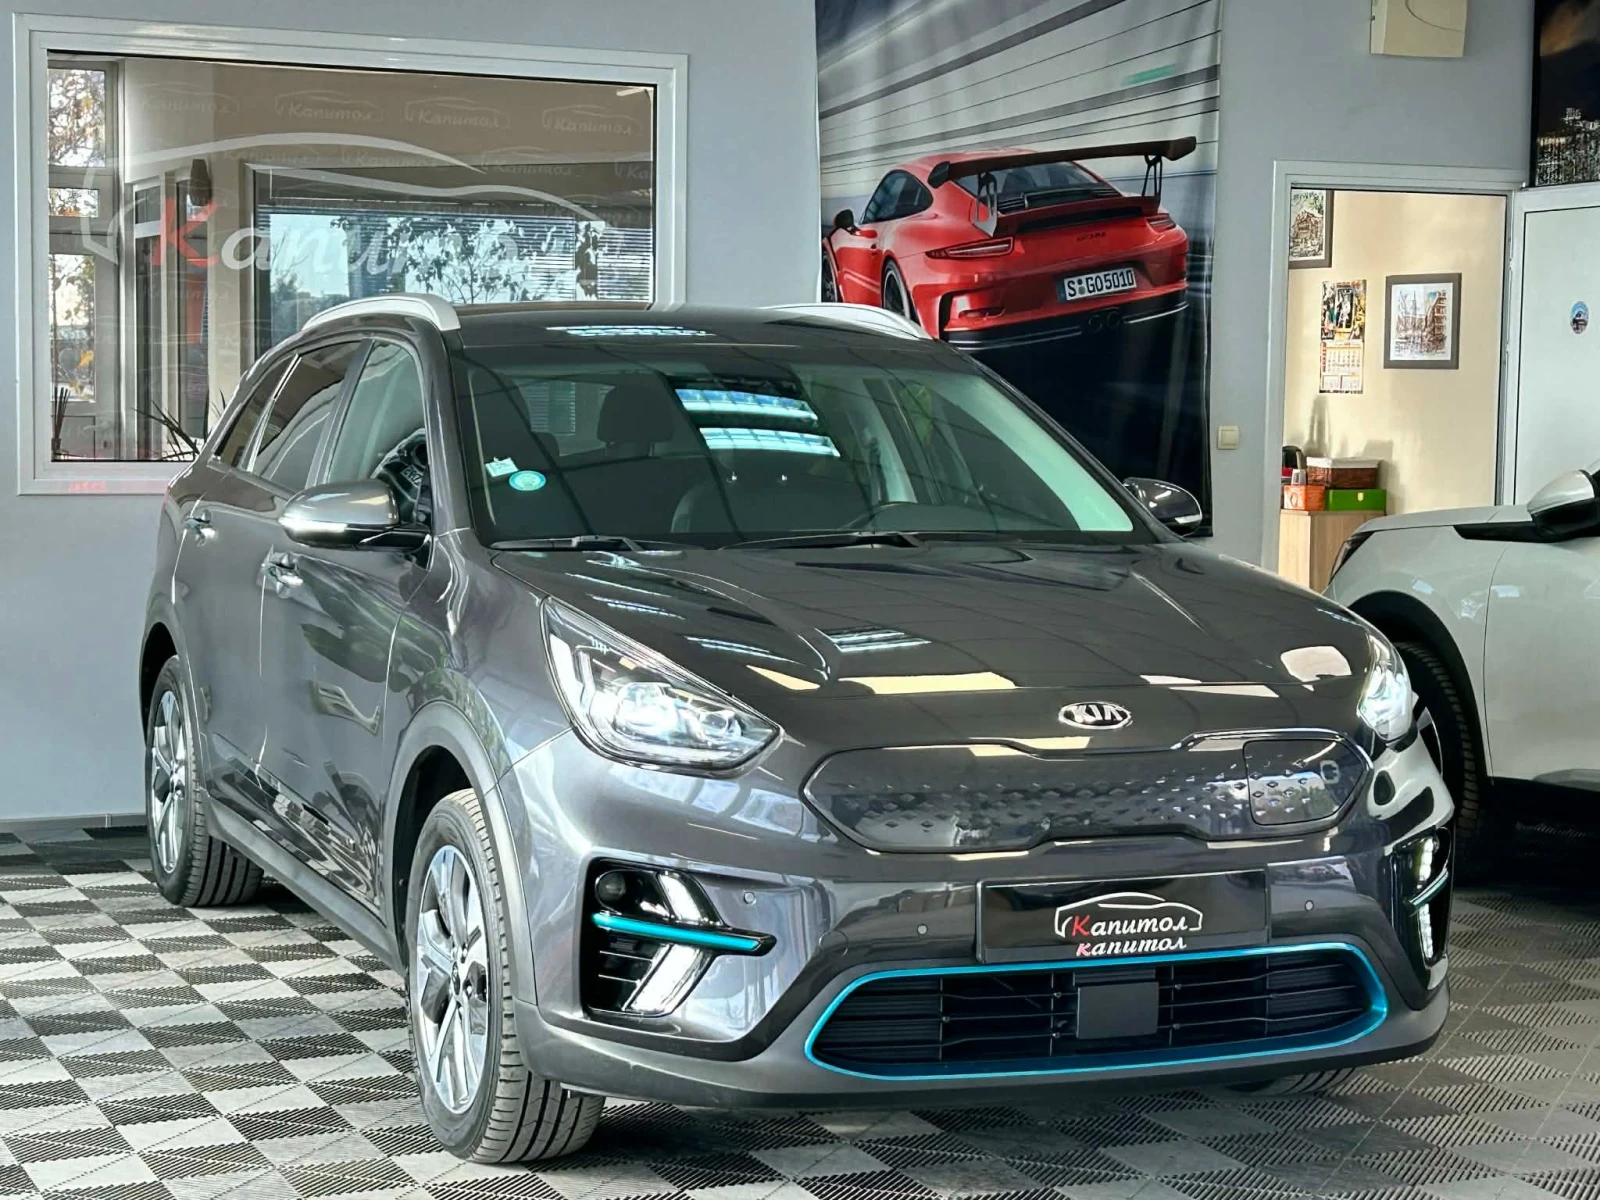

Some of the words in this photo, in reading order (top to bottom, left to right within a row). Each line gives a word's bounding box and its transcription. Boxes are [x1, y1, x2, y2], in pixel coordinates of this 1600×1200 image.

[151, 199, 580, 285] Капито
[1072, 703, 1124, 724] KIA
[1071, 915, 1188, 937] Капитол
